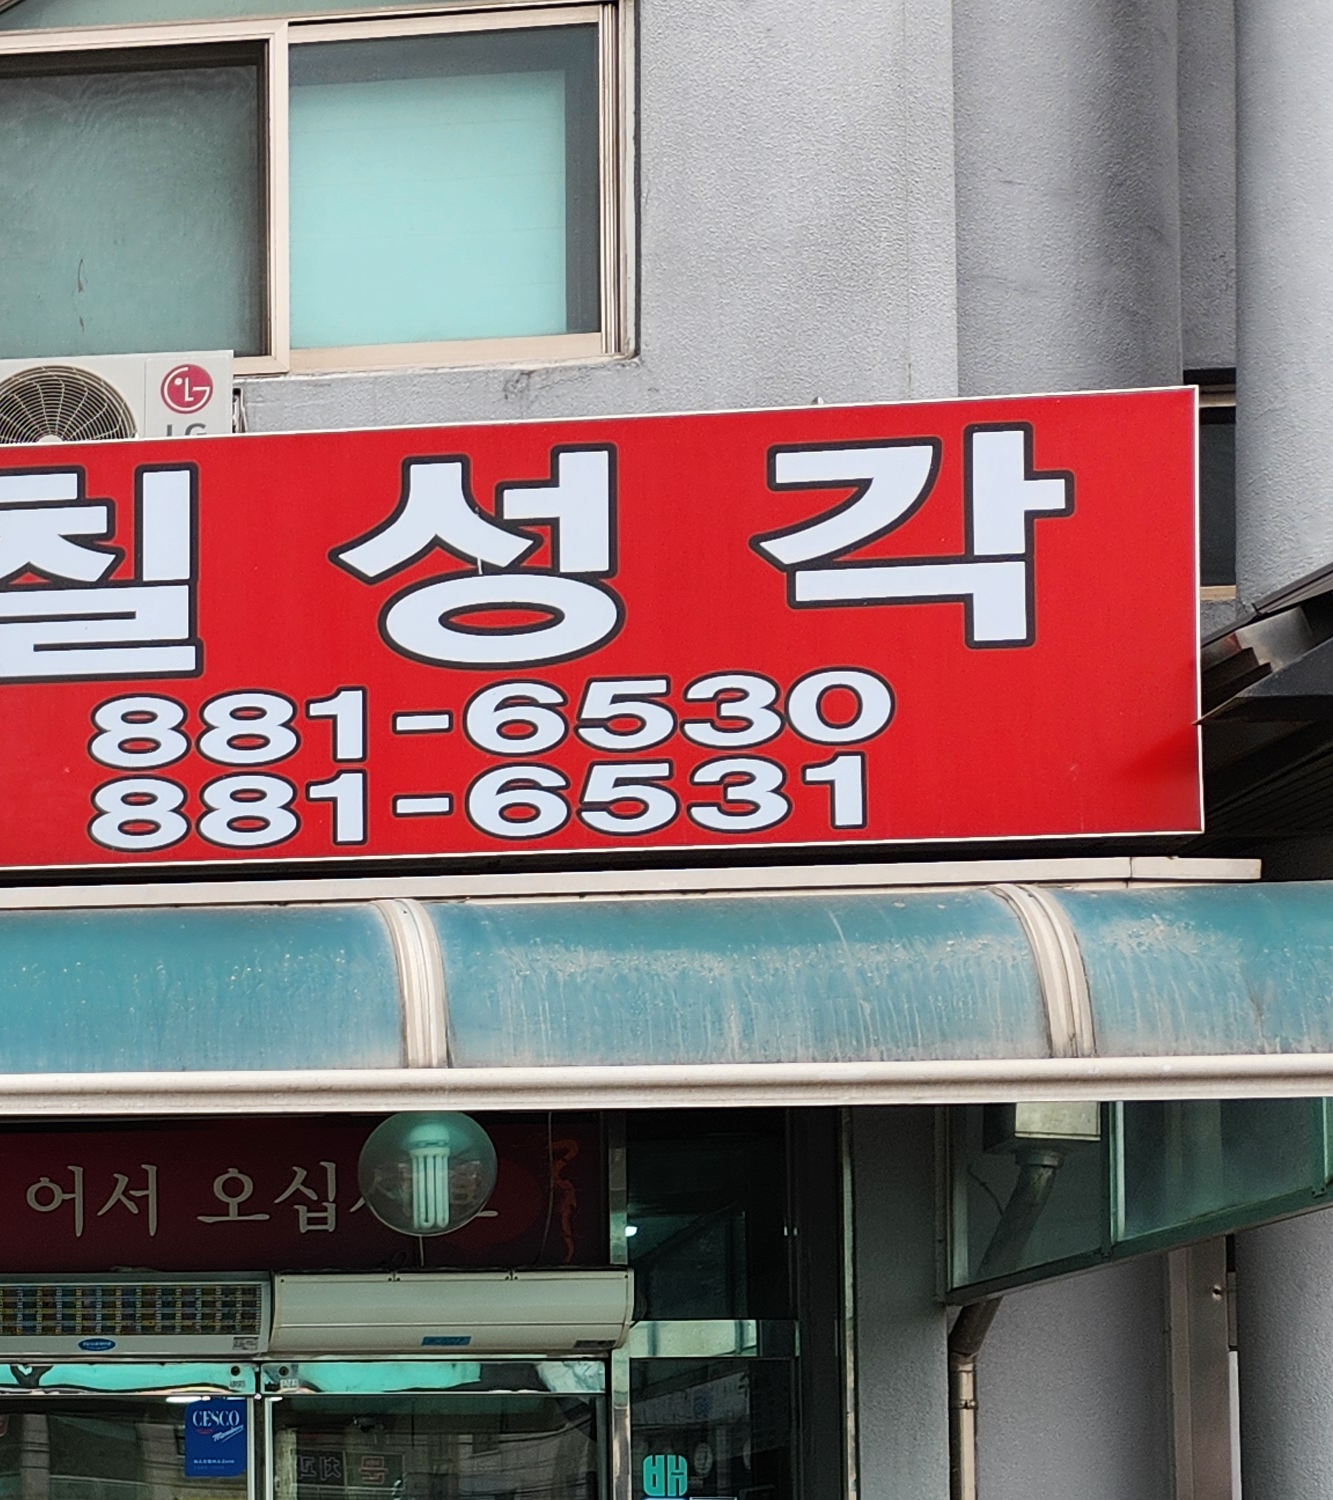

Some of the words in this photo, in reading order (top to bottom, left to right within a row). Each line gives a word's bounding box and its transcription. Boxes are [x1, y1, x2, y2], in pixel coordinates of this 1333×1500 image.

[87, 667, 895, 772] 881-6530
[87, 752, 868, 853] 881-6531
[26, 1163, 158, 1238] 어서
[197, 1160, 499, 1234] 오십
[192, 1409, 240, 1427] CESCO
